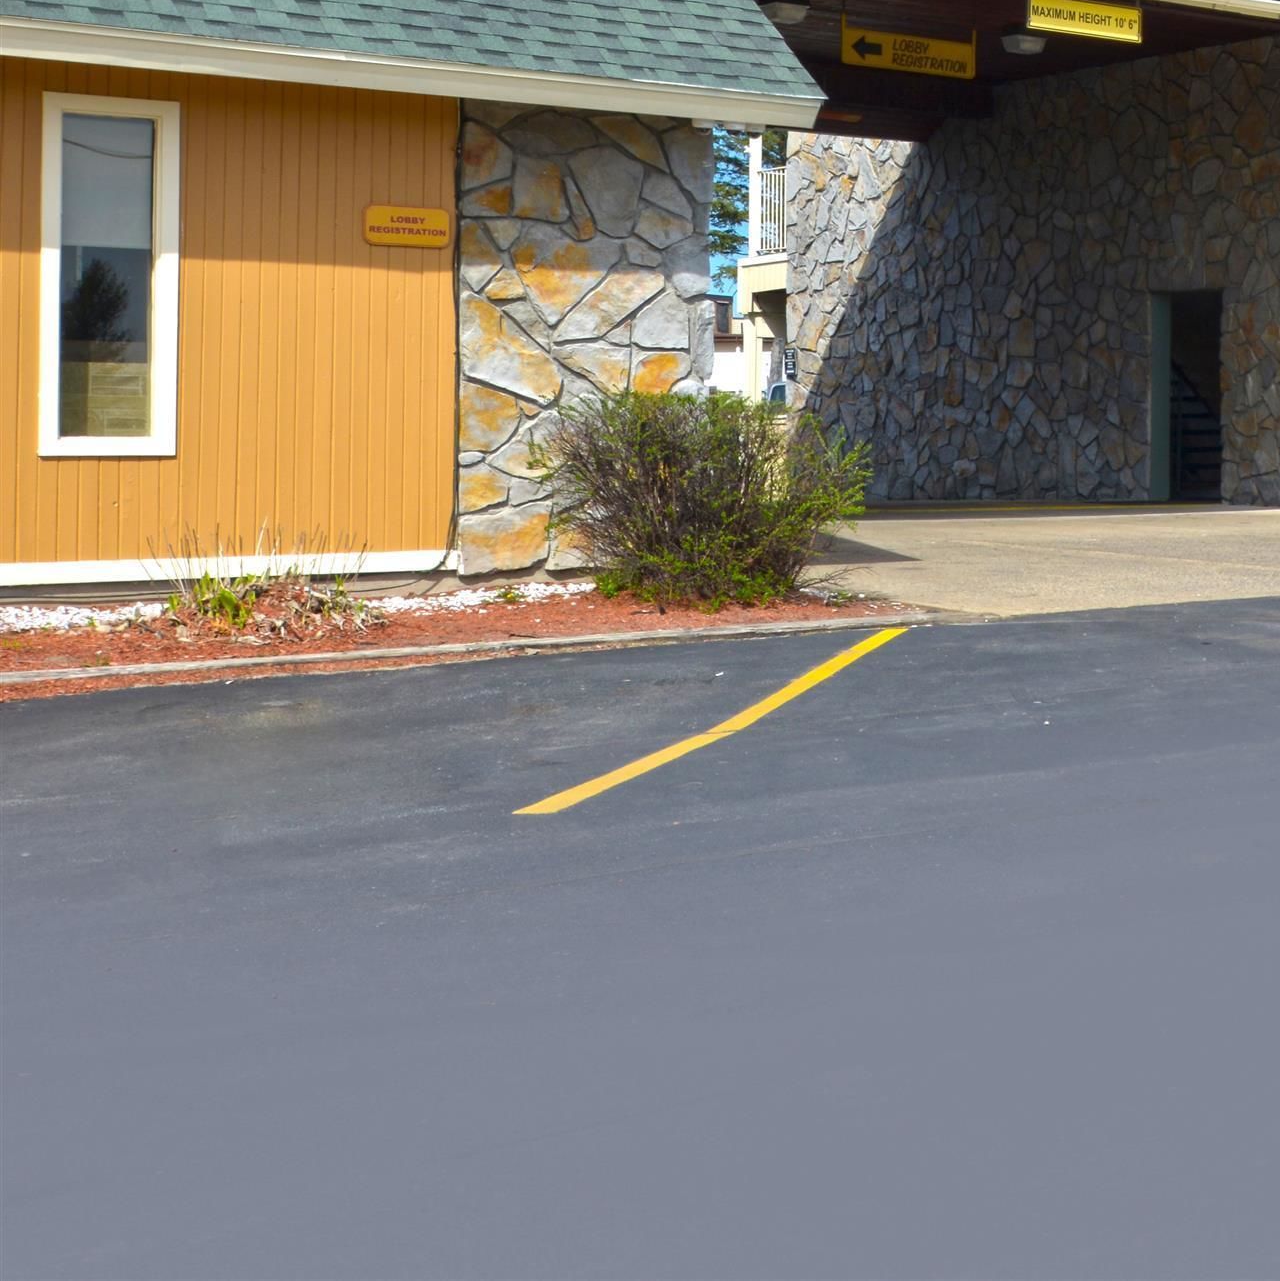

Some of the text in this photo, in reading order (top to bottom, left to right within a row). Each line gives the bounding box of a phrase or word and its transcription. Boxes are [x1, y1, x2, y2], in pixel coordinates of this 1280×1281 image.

[1031, 4, 1076, 23] MAXIMUM
[1078, 11, 1112, 26] HEIGHT
[1114, 17, 1126, 29] 10'
[892, 38, 929, 55] LOBBY
[892, 53, 967, 74] REGISTRATION
[390, 216, 426, 224] LOBBY
[369, 225, 446, 236] REGISTRATION
